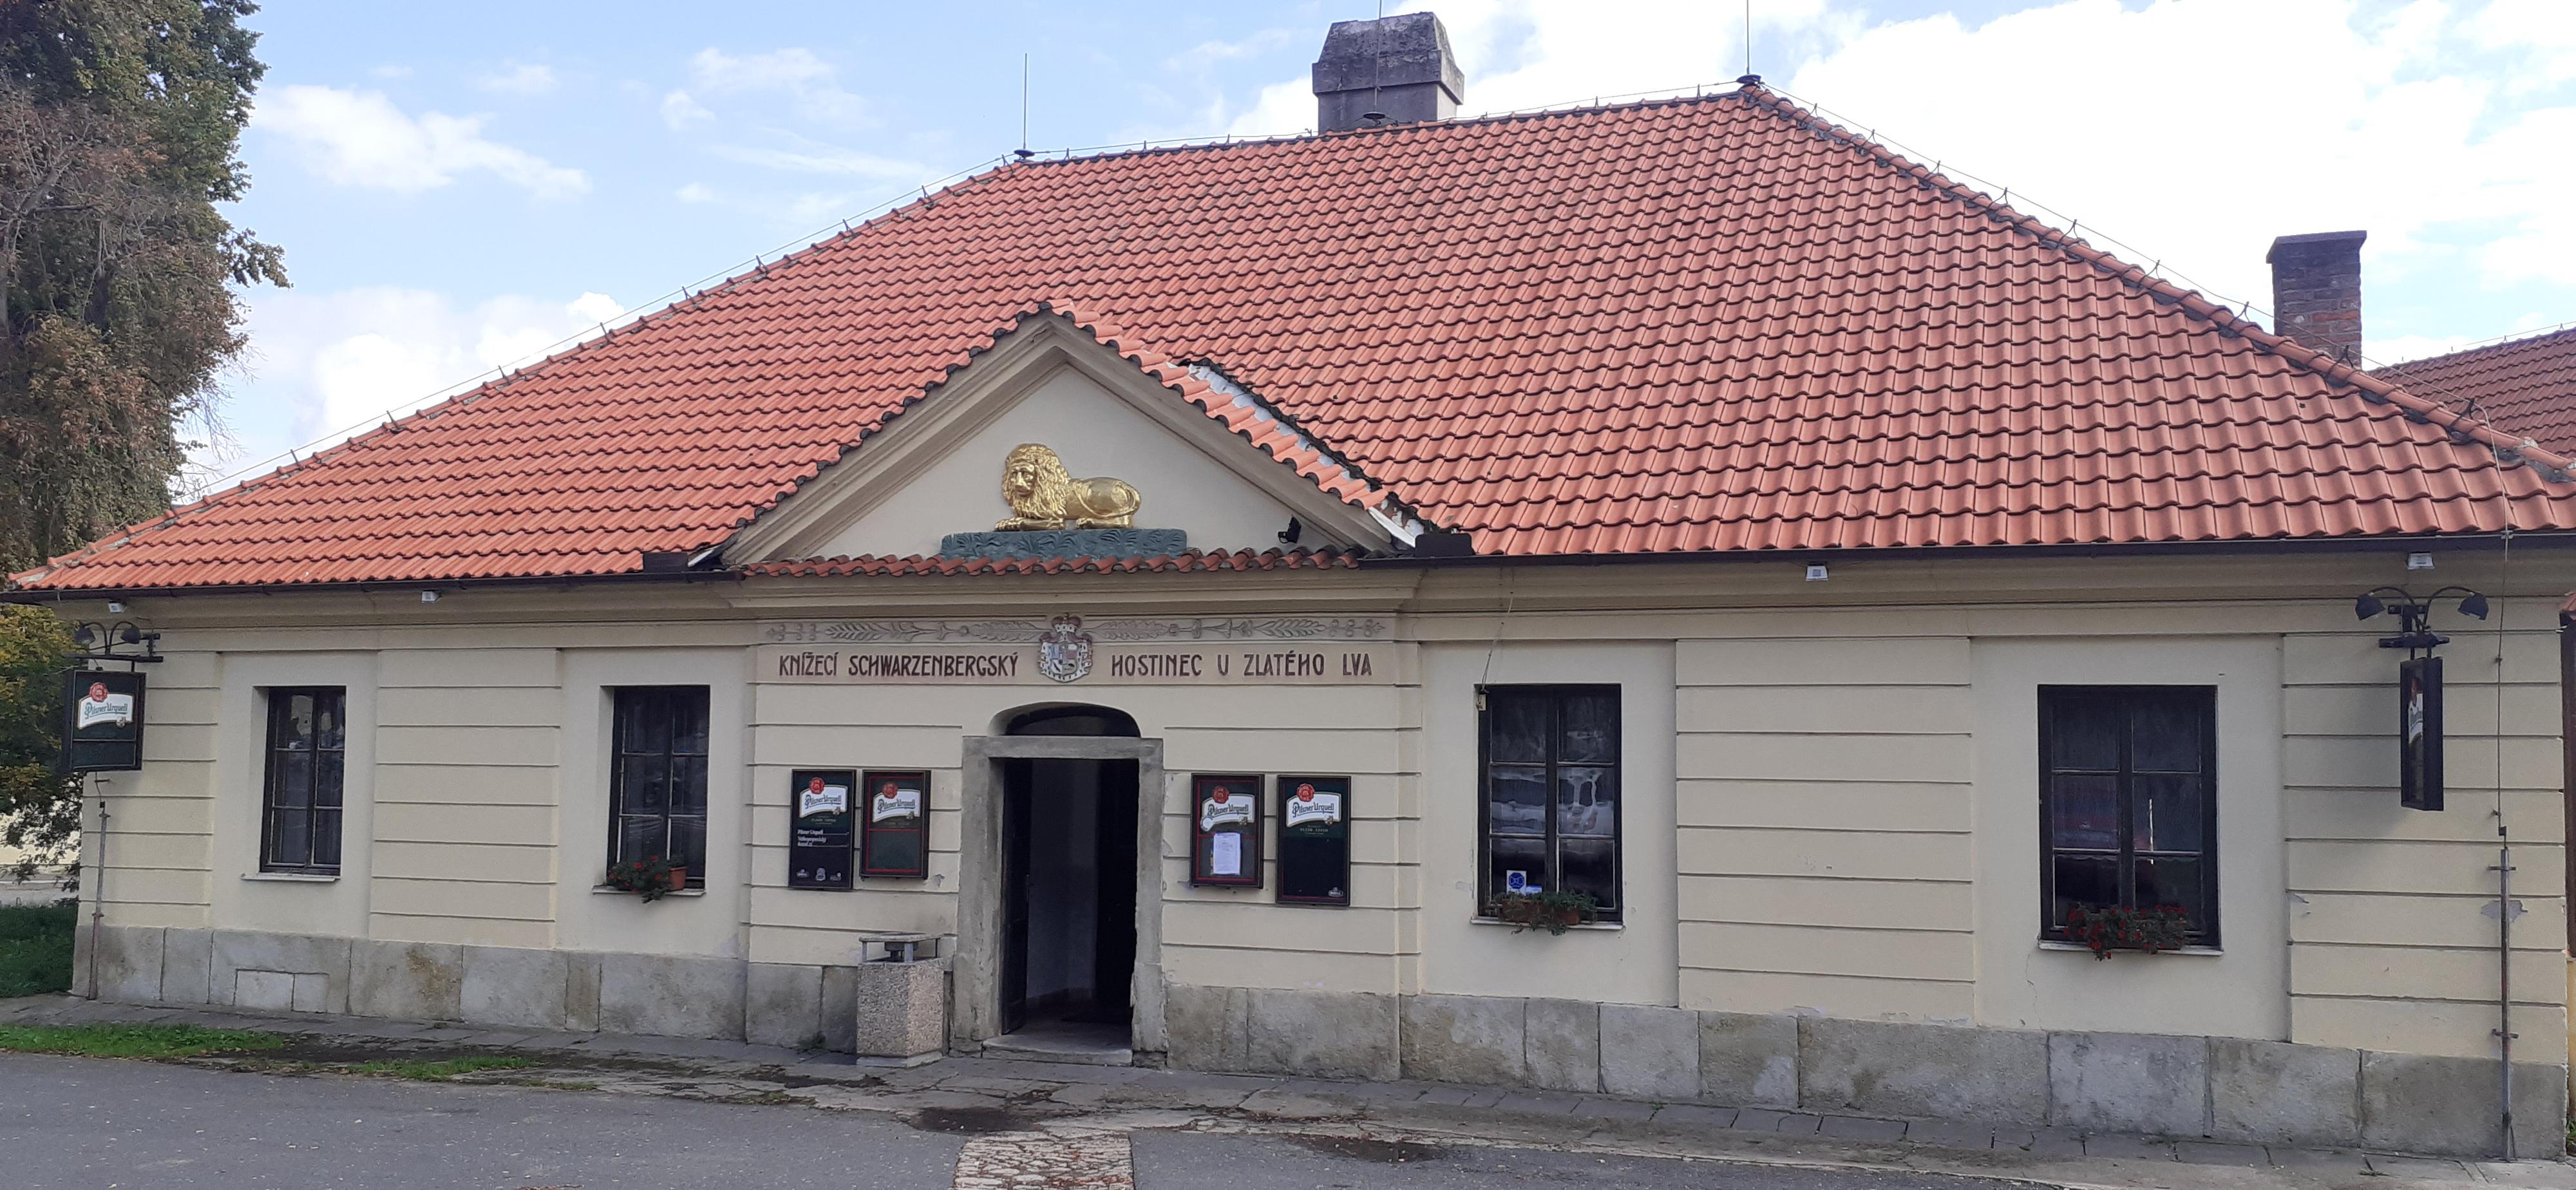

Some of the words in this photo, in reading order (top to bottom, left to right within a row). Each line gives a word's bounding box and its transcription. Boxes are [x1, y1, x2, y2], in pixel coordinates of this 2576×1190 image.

[780, 652, 839, 676] KNÍŽECÍ
[848, 652, 1019, 677] SCHWARZENBERGSKÝ
[1112, 654, 1203, 677] HOSTINEC
[1217, 654, 1230, 676] U
[1244, 650, 1325, 676] ZLATÉHO
[1343, 653, 1372, 676] LVA
[84, 702, 107, 719] Pilsner
[106, 702, 128, 715] Urquell
[804, 794, 824, 809] Pilsner
[823, 794, 842, 805] Urquell
[878, 798, 897, 814] Pilsner
[896, 798, 915, 809] Urquell
[1207, 804, 1229, 817] Pilsner
[1228, 804, 1249, 815] Urquell
[1292, 802, 1314, 818] Pilsner
[1313, 802, 1334, 814] Urquell
